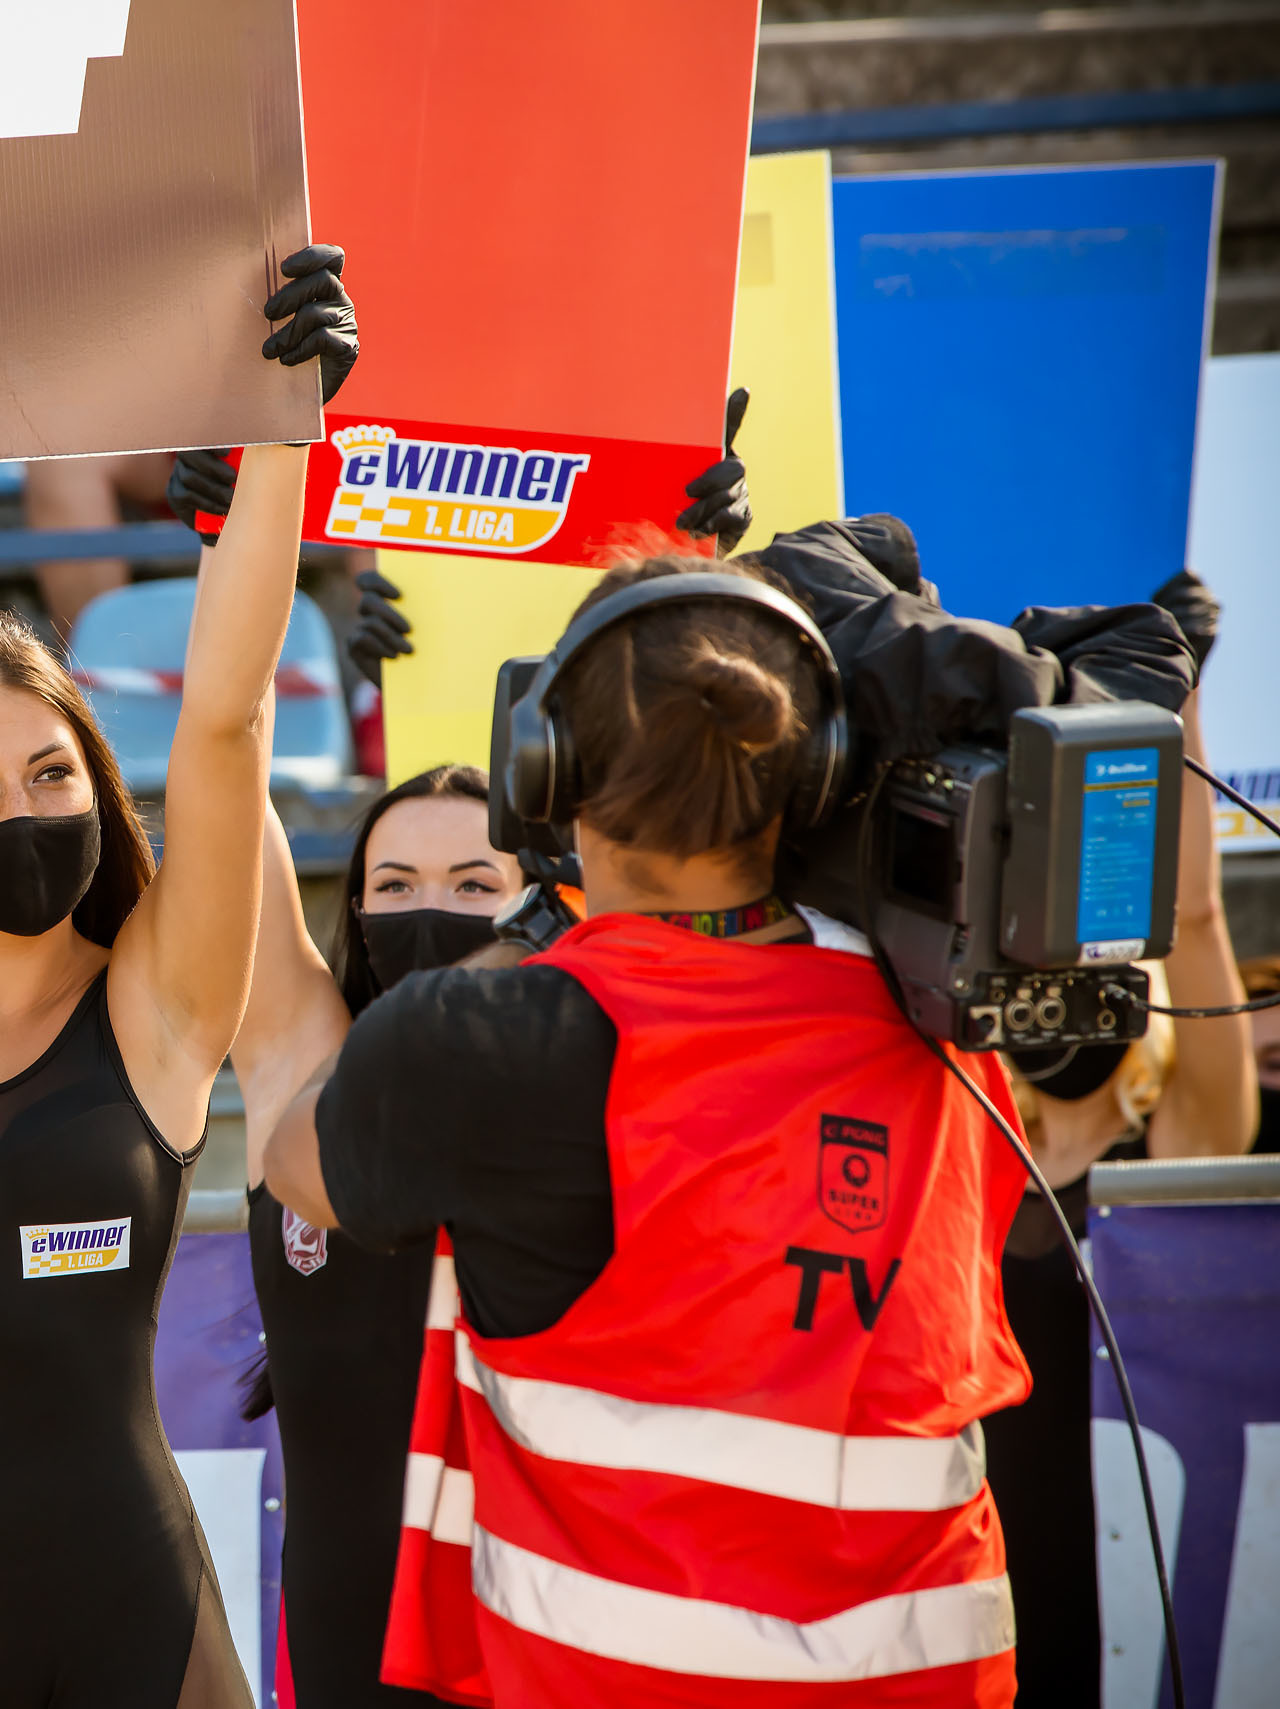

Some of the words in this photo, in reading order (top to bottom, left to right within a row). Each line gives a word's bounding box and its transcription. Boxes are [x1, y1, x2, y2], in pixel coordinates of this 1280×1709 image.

[424, 505, 443, 536] 1.
[447, 509, 515, 542] LIGA
[67, 1254, 76, 1269] 1.
[77, 1252, 104, 1267] LIGA
[784, 1245, 903, 1332] TV
